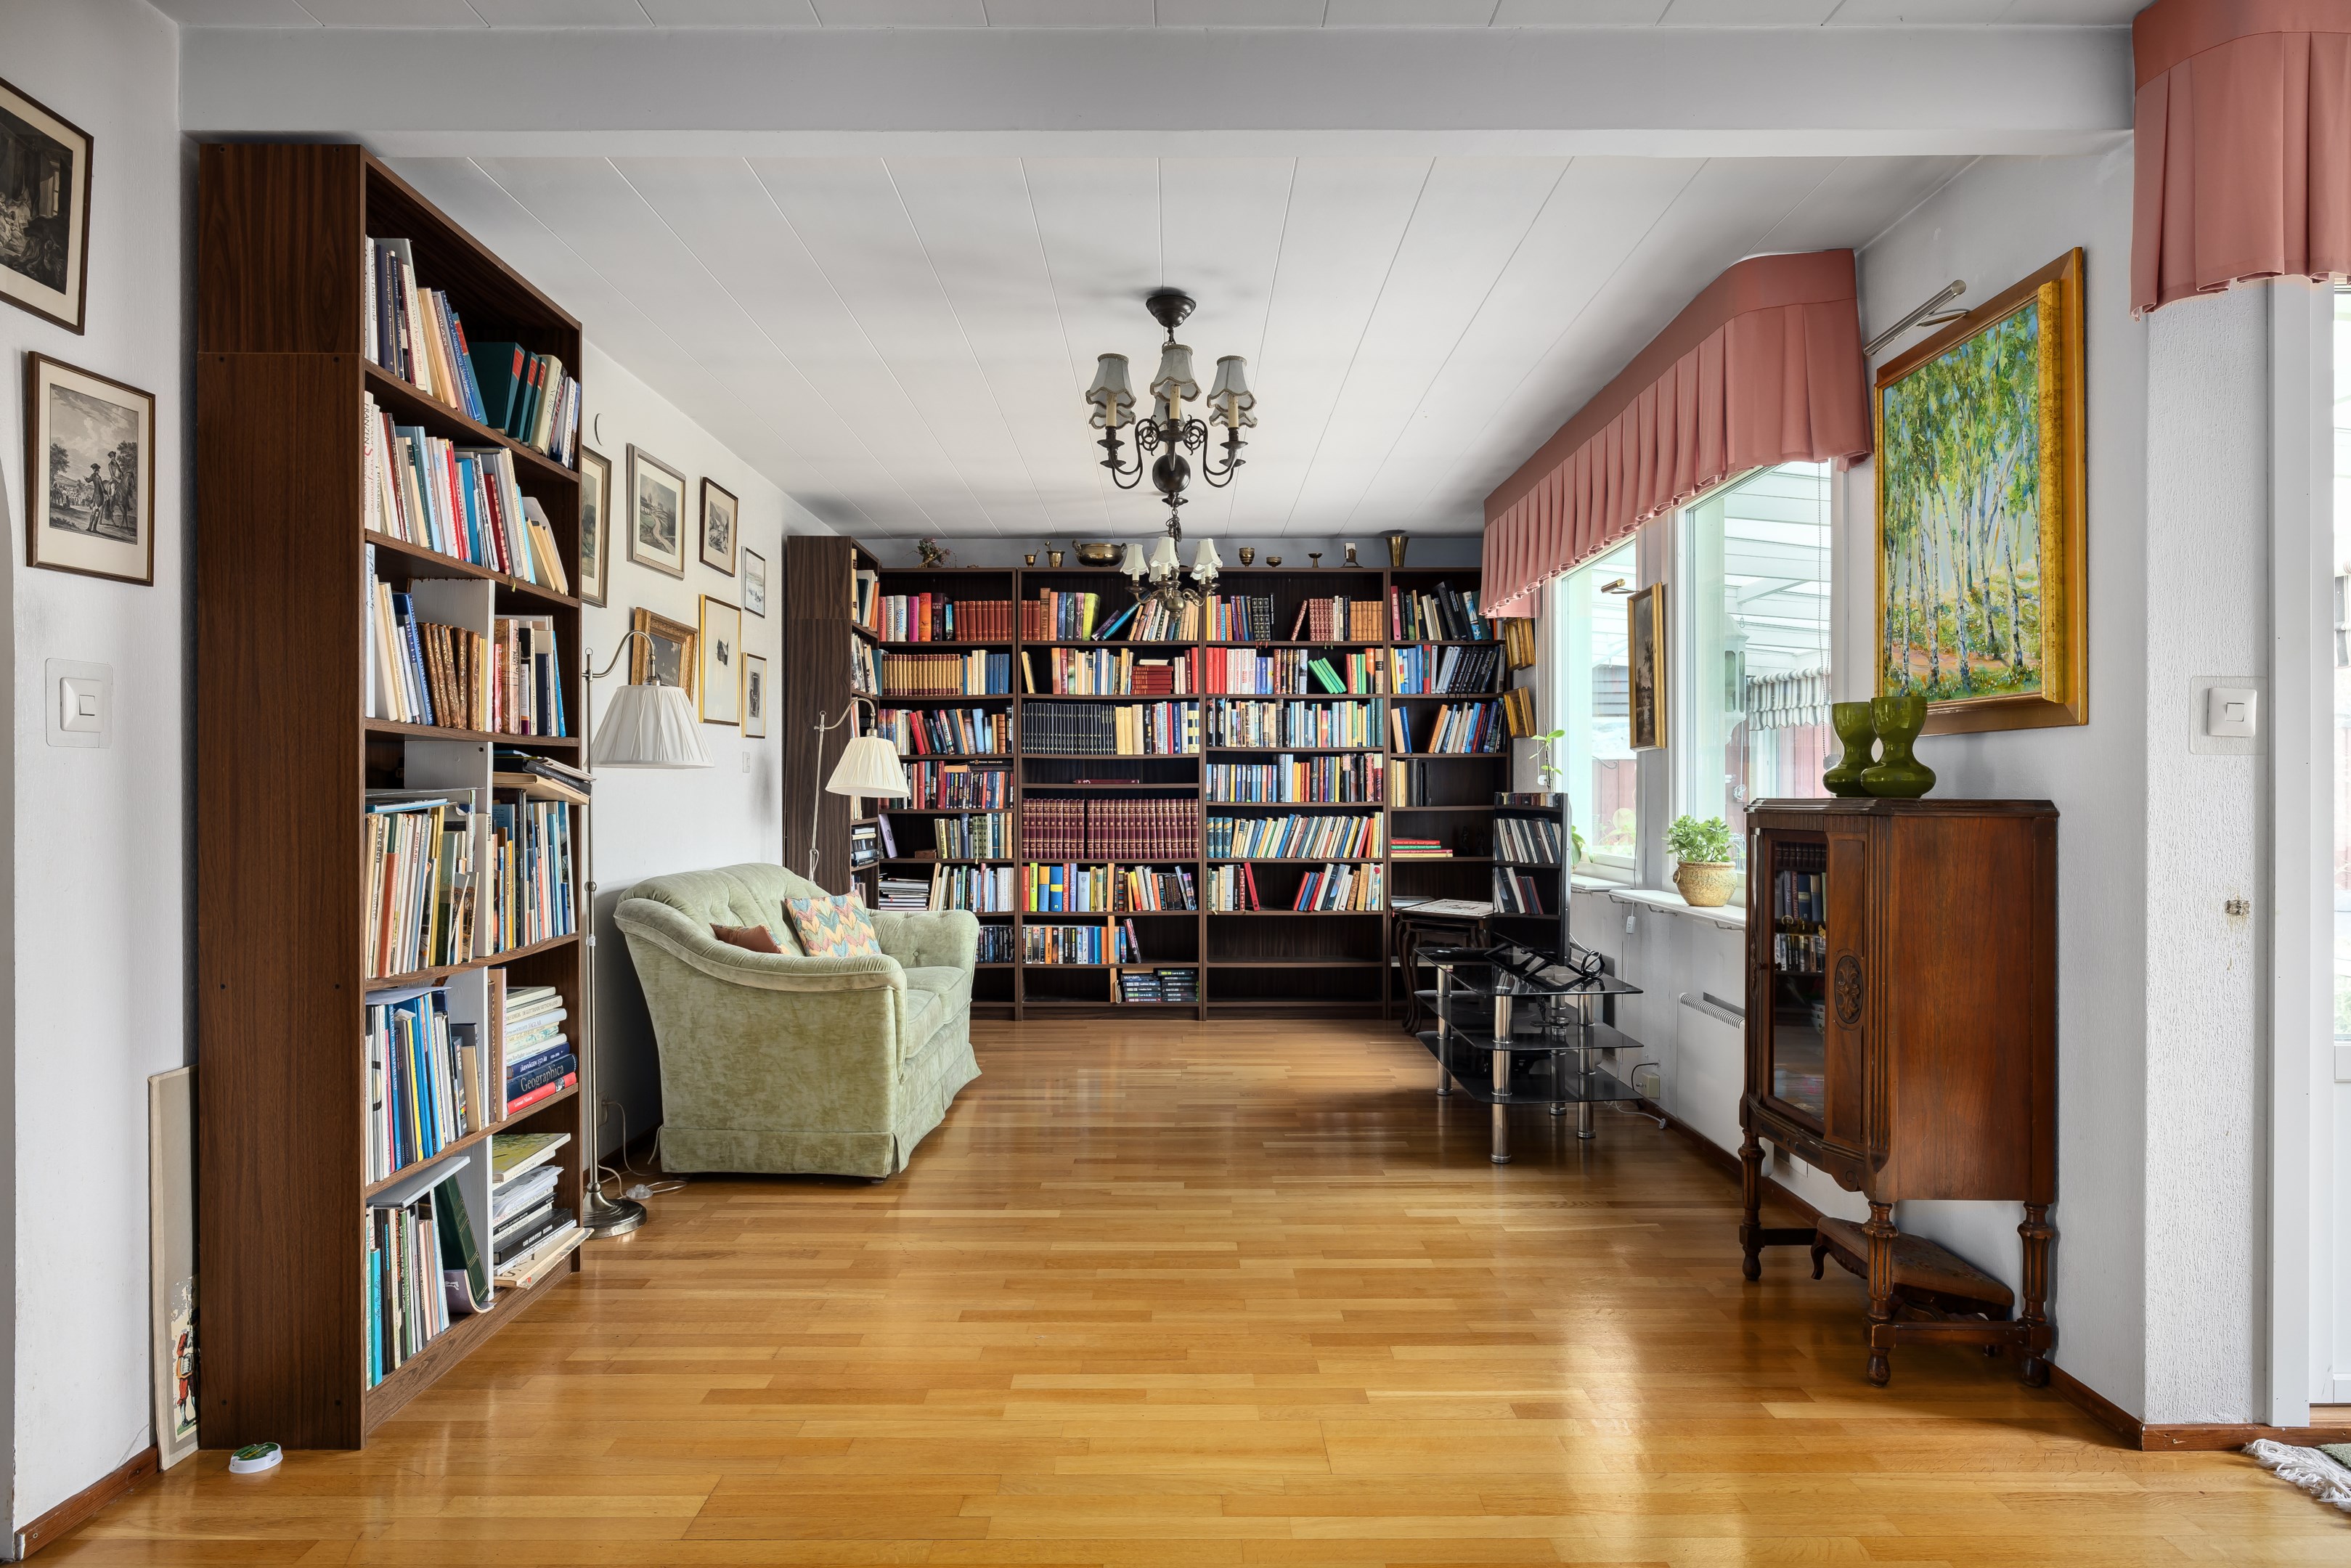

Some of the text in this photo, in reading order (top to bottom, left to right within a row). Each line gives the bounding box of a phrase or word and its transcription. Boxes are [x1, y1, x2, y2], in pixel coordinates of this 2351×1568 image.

[437, 307, 447, 346] CARLZON
[546, 387, 555, 416] NOBEL
[521, 1064, 564, 1092] Geographica
